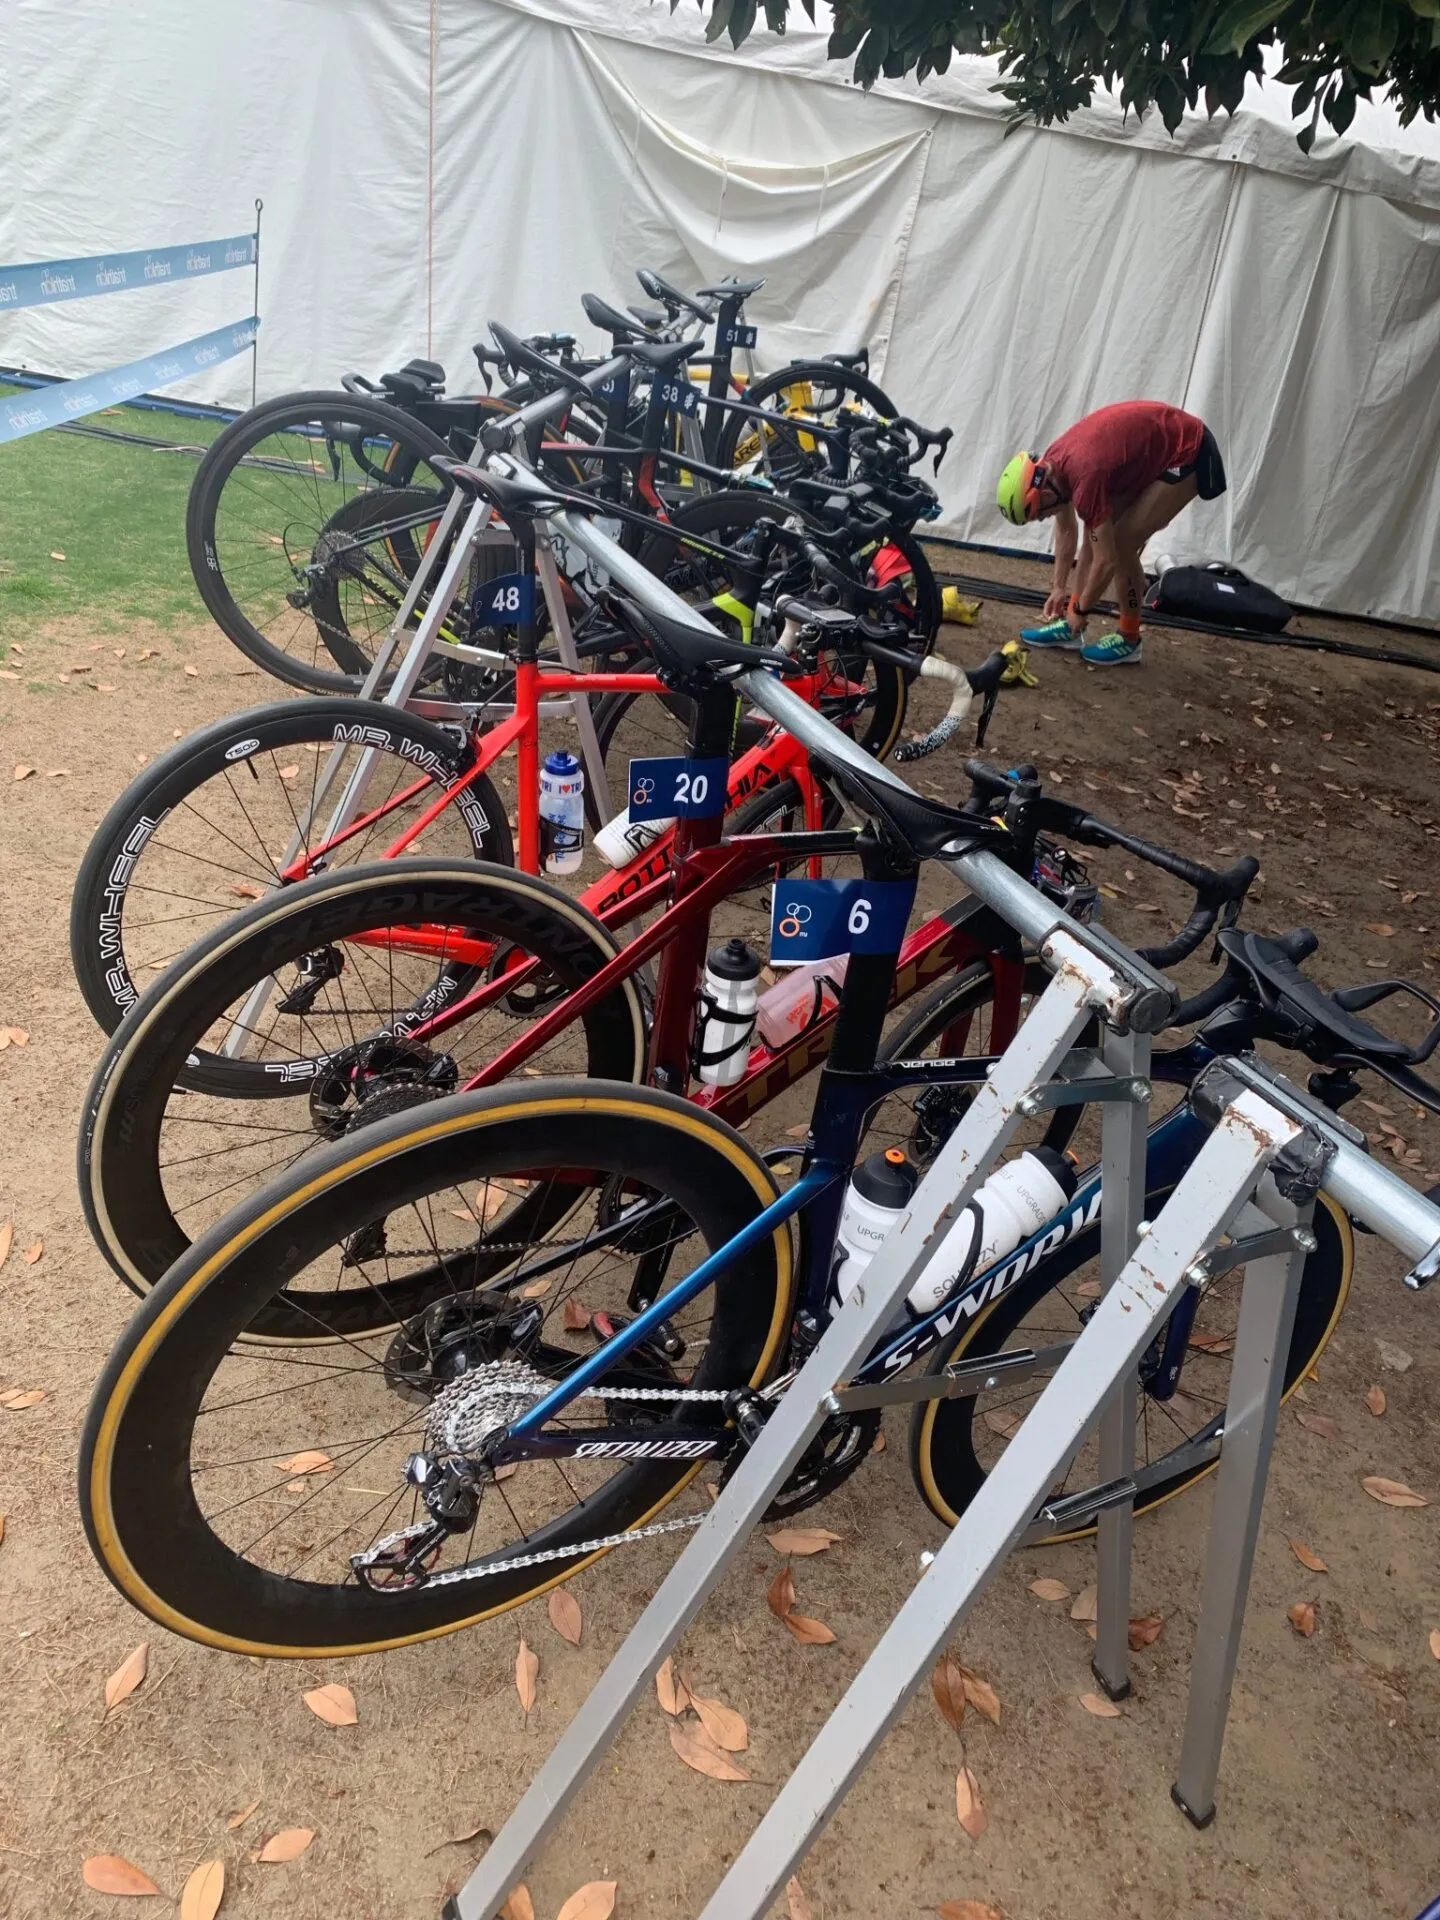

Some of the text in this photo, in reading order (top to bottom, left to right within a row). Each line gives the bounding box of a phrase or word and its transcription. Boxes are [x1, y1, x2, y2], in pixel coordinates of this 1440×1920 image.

[726, 329, 738, 342] 51
[662, 384, 678, 403] 38
[491, 586, 520, 612] 48
[332, 723, 395, 751] MR.
[673, 772, 709, 804] 20
[99, 807, 172, 1018] MR. WHEEL
[848, 898, 873, 935] 6
[856, 1224, 886, 1242] UPGR
[932, 1240, 998, 1299] SQUZY
[881, 1188, 1103, 1384] S-WORK
[570, 1440, 718, 1459] SPECIALIZED
